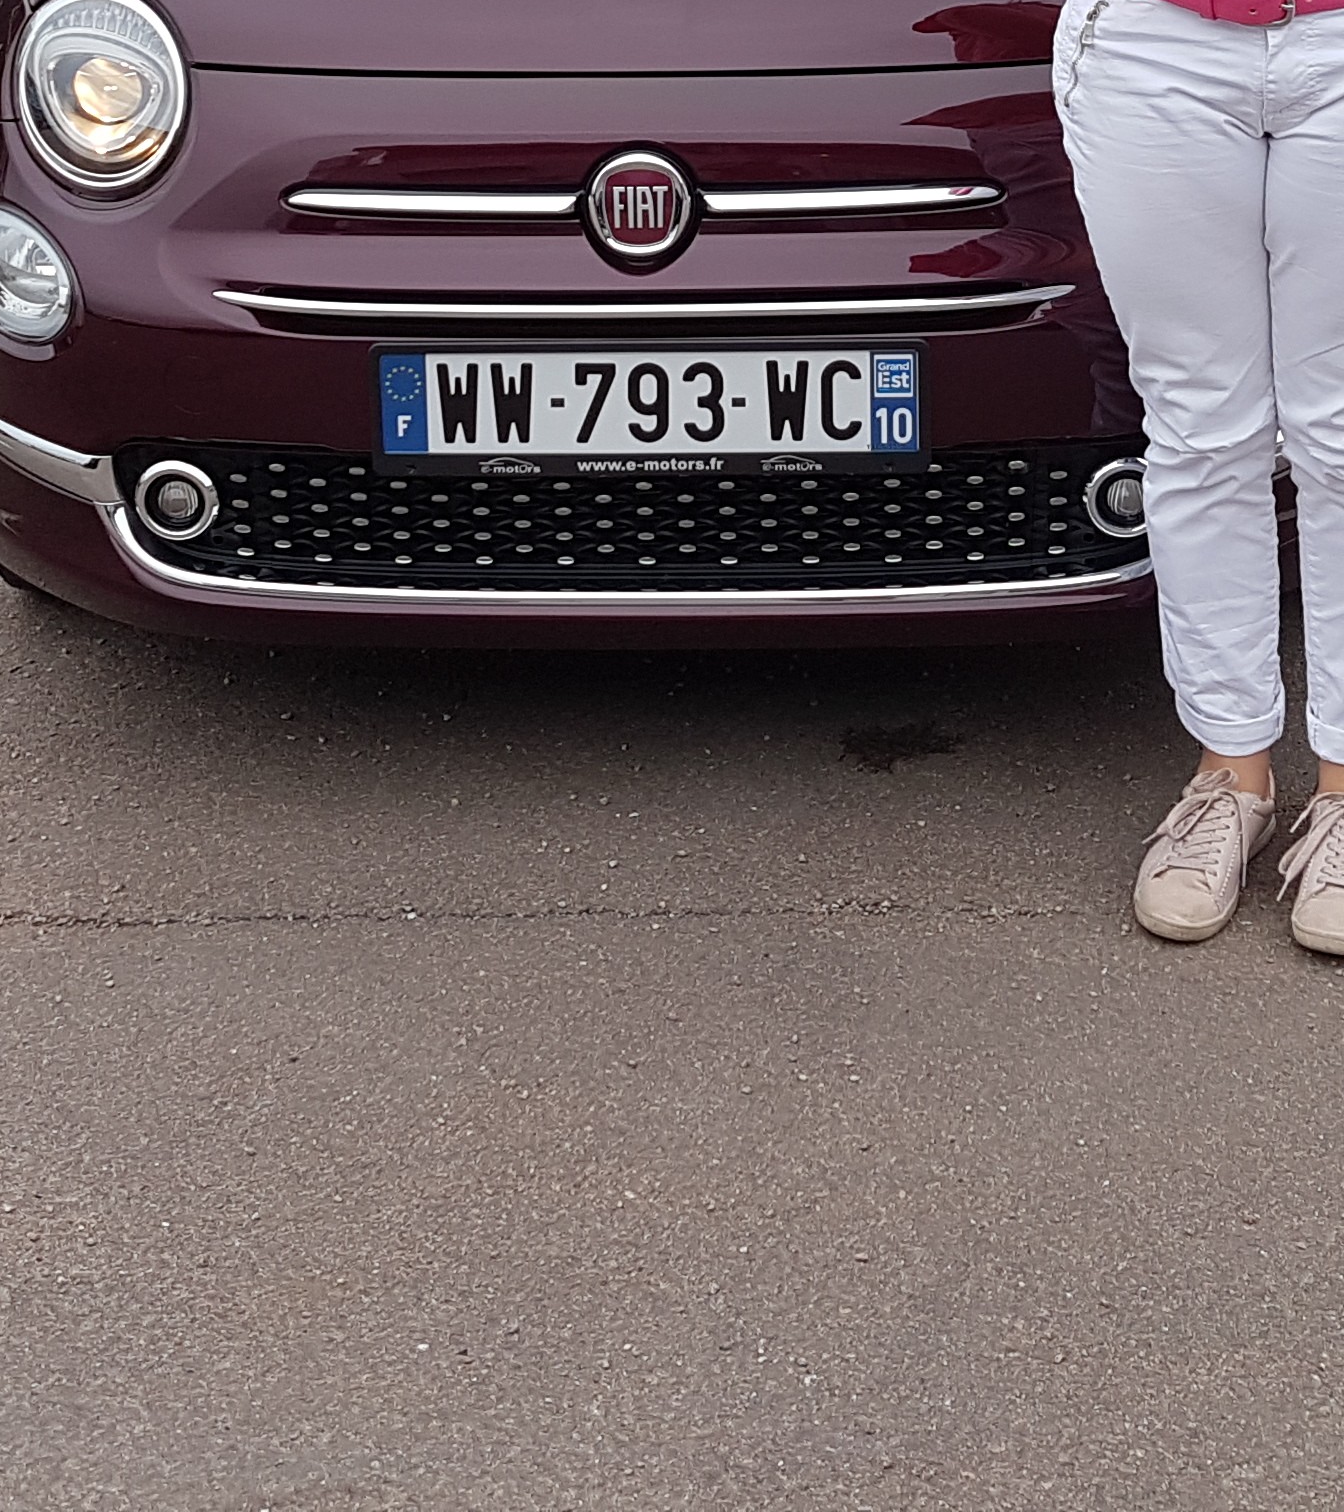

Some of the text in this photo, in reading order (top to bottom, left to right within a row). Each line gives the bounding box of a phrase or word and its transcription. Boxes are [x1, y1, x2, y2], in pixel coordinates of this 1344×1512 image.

[612, 185, 669, 229] FIAT
[877, 361, 910, 371] Grand
[877, 371, 910, 388] Est
[436, 359, 863, 444] WW-793-WC
[397, 415, 412, 437] F
[875, 407, 913, 444] 10
[576, 457, 725, 472] www.e-motors.fr
